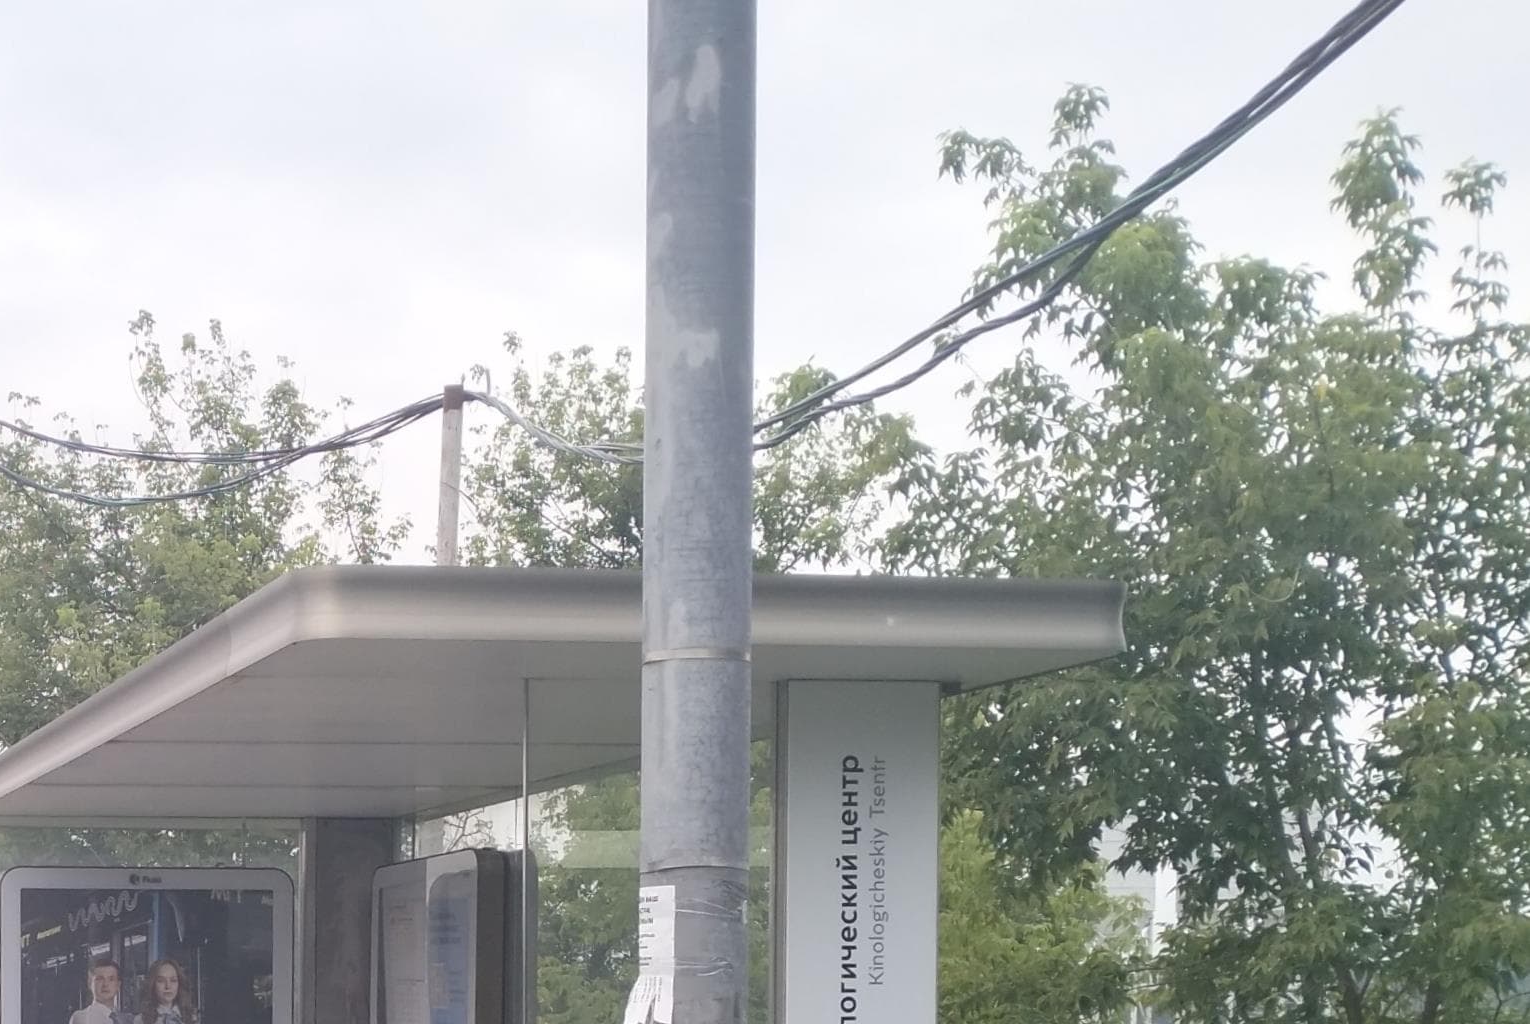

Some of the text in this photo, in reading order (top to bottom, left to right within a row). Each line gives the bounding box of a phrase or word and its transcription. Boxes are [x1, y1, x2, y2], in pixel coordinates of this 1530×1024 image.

[841, 754, 864, 845] центр
[868, 755, 889, 986] Kinologicheskiy Tsentr
